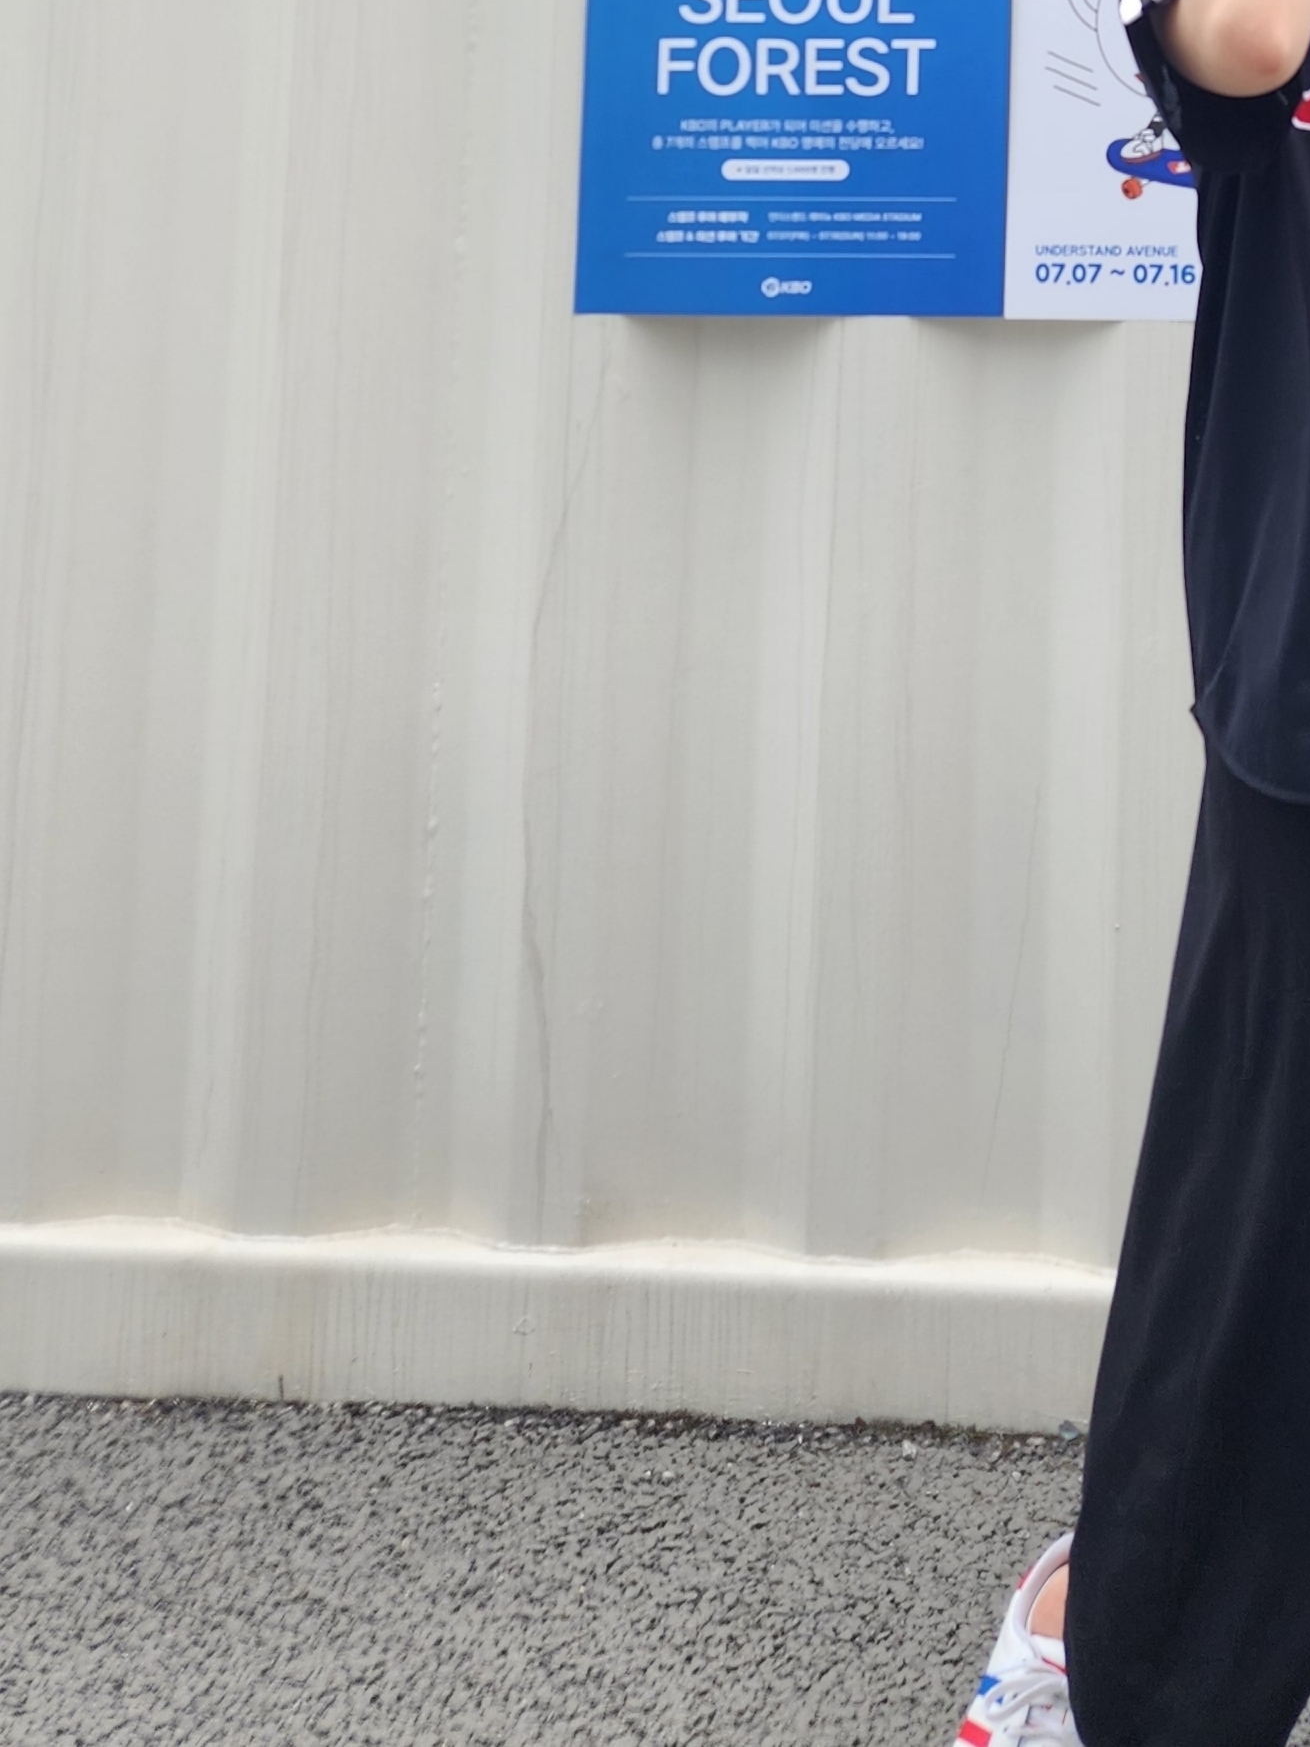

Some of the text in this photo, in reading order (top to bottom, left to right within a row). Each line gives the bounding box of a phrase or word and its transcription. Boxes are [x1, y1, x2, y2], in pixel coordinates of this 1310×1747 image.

[657, 37, 936, 96] FOREST
[1036, 245, 1178, 257] UNDERSTAND AVENUE
[1036, 263, 1102, 285] 07.07
[1133, 264, 1195, 285] 07.16
